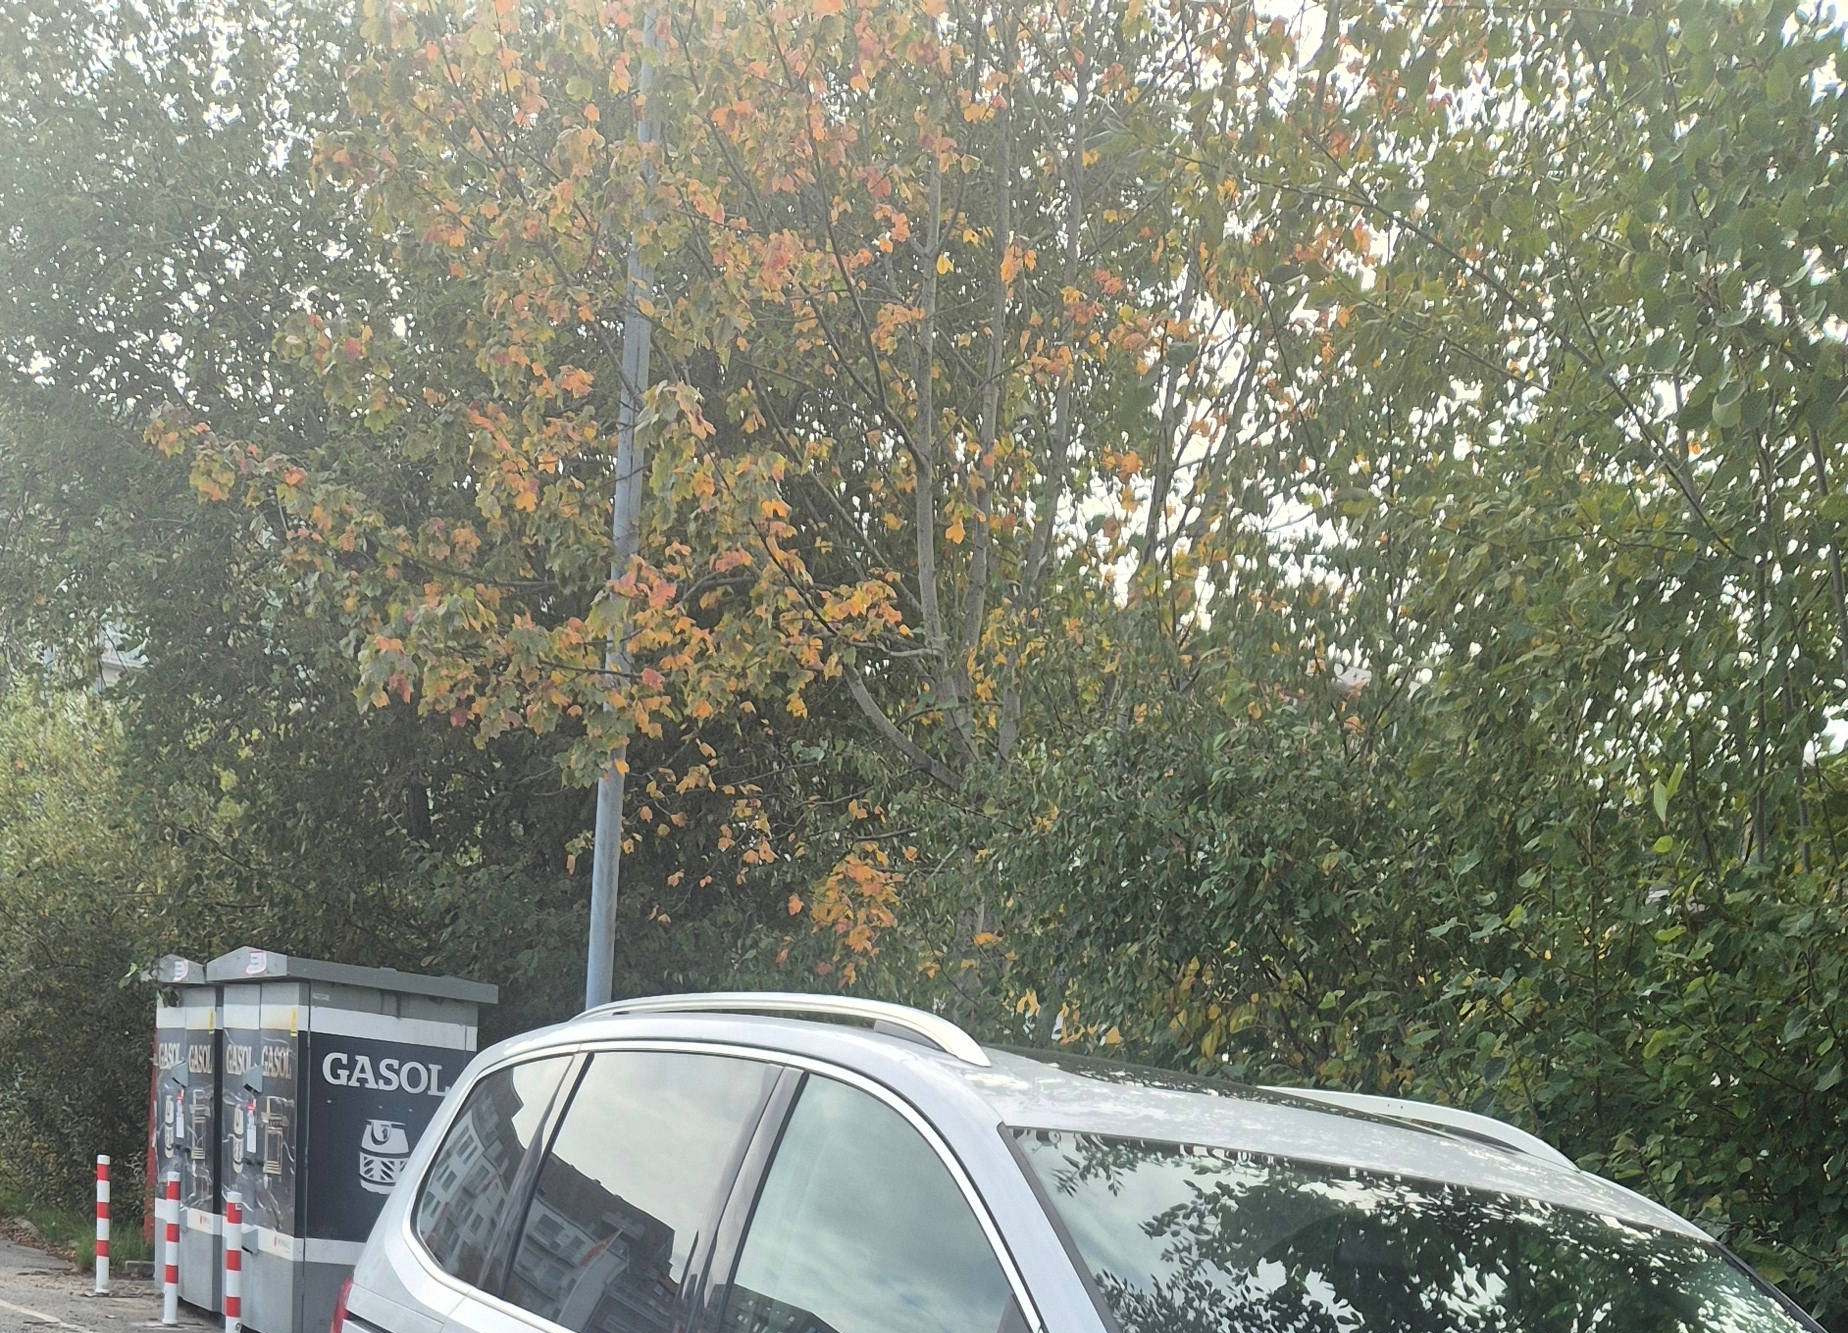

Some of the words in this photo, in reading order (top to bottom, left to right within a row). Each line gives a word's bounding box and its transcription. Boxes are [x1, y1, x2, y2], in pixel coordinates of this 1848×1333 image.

[159, 1042, 185, 1070] GASOL
[188, 1044, 213, 1074] GASOL
[226, 1044, 257, 1075] GASOL
[262, 1045, 292, 1079] GASOL
[321, 1052, 451, 1097] GASOL
